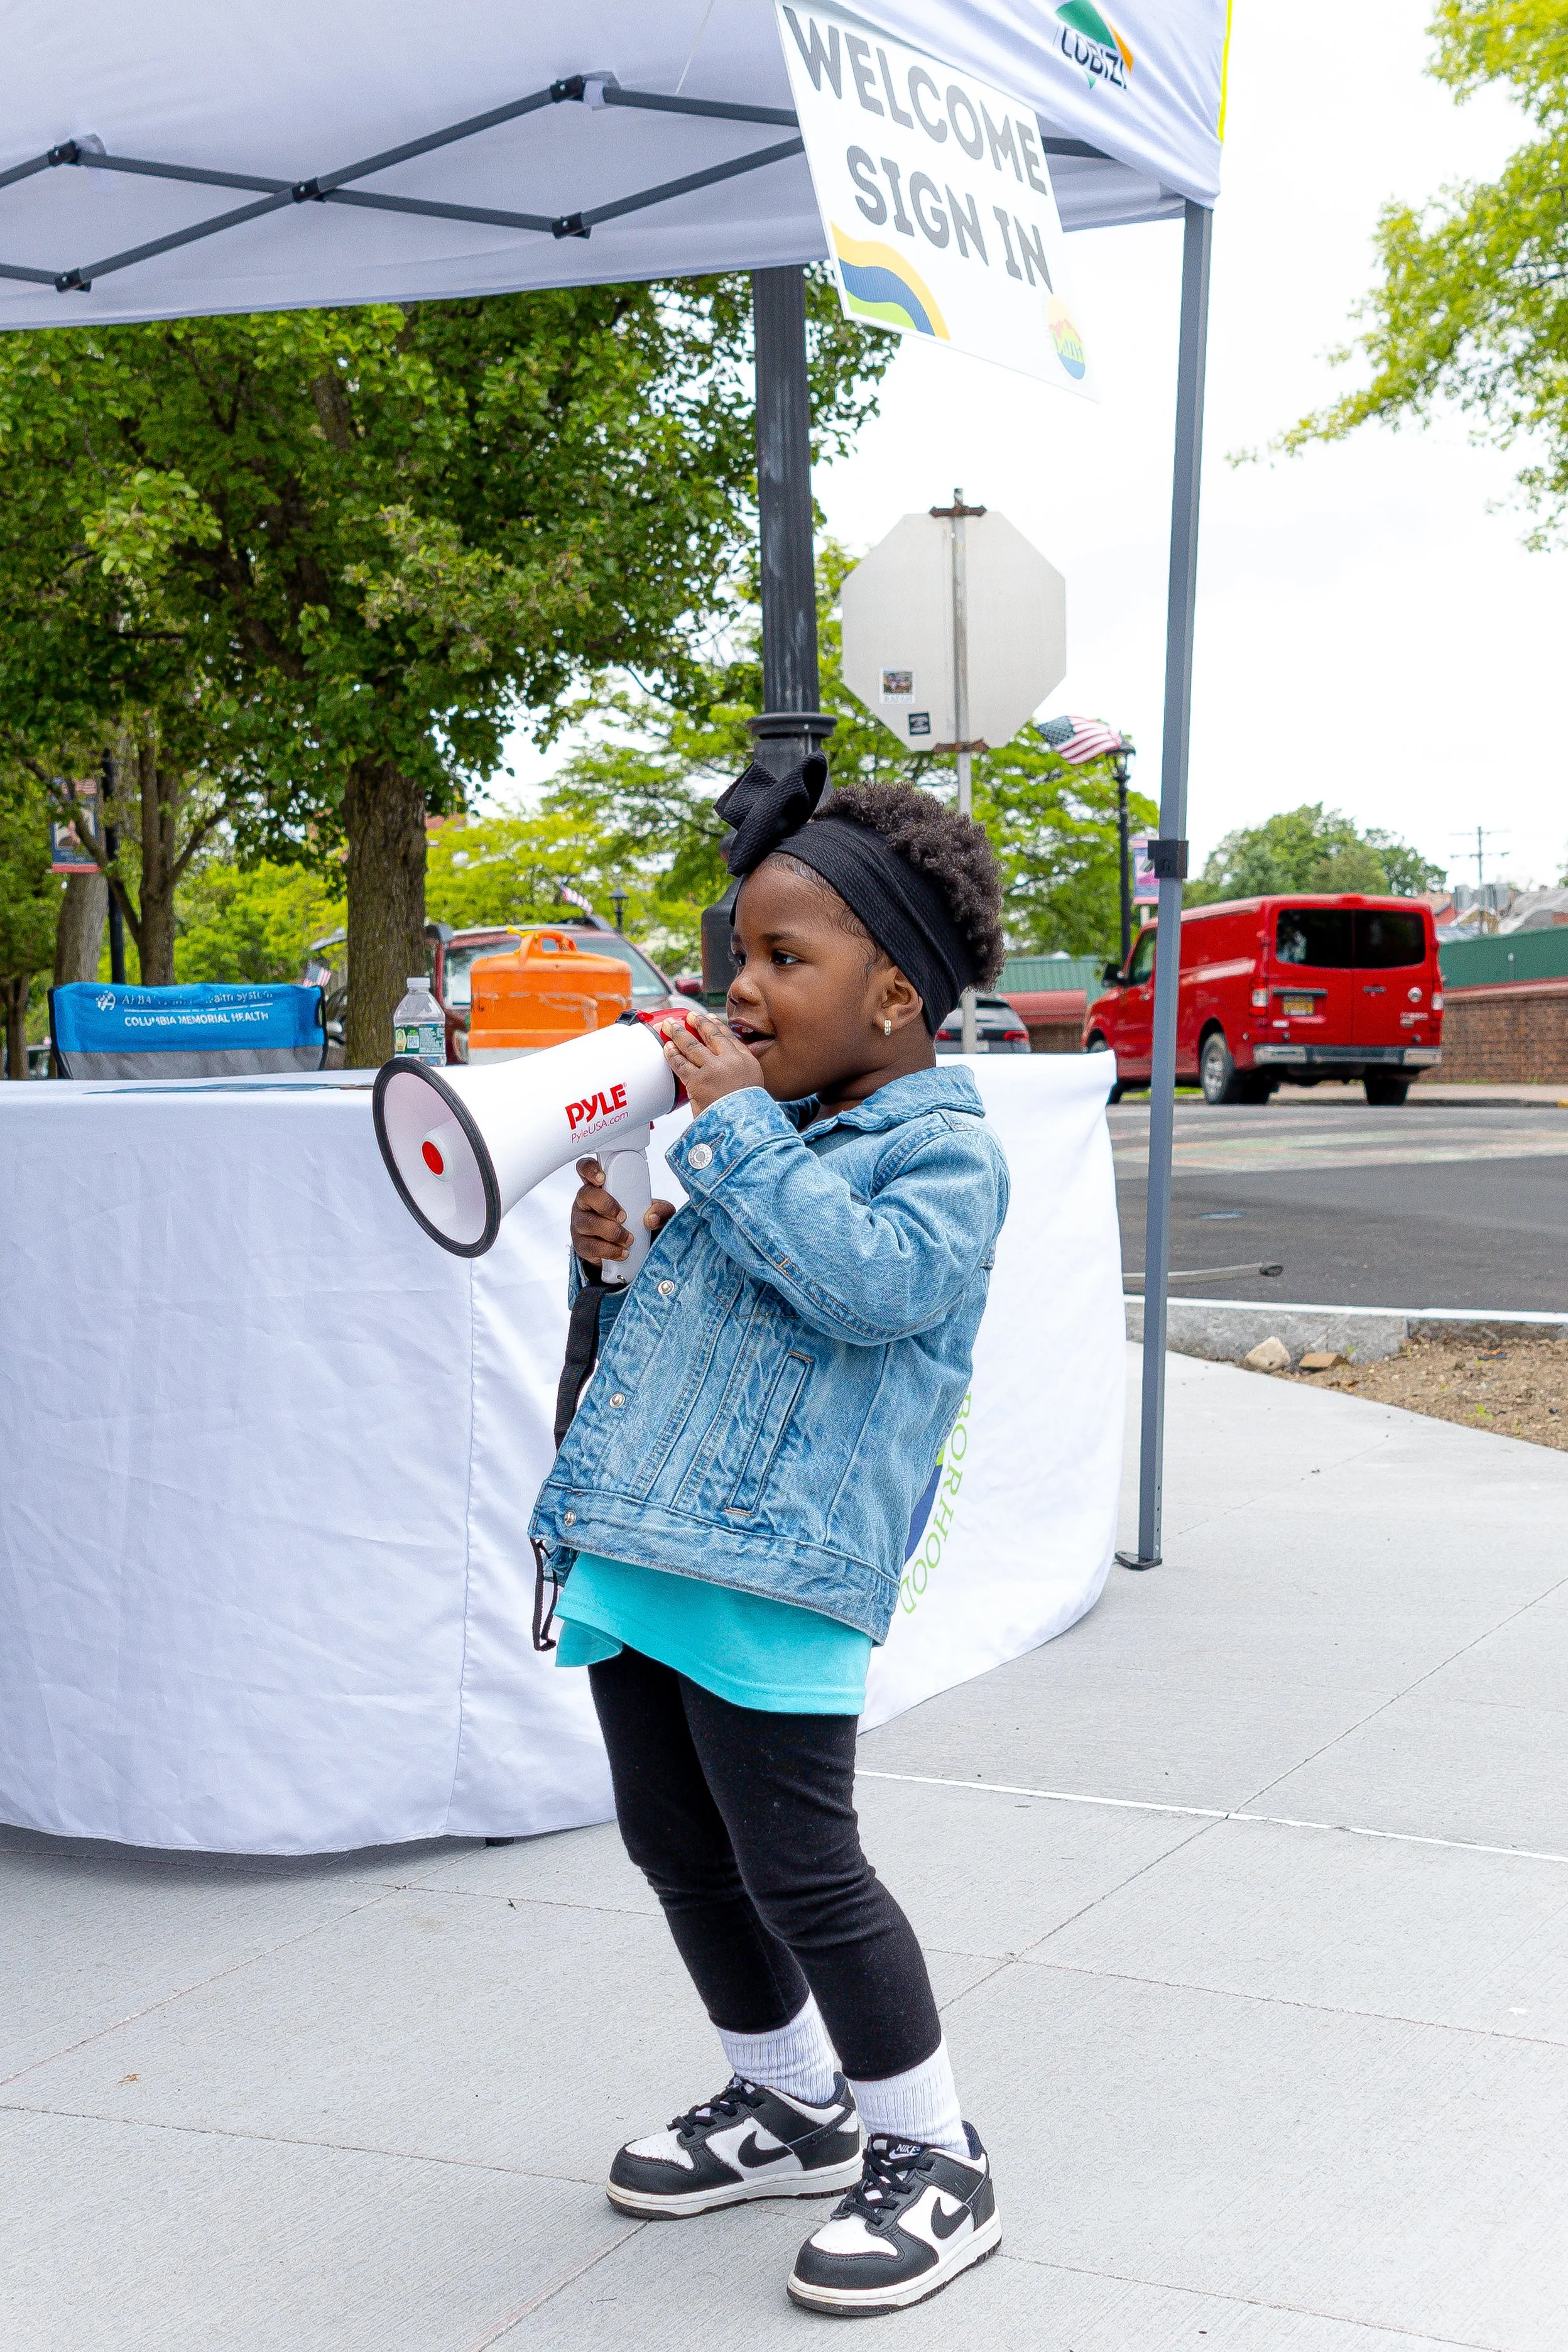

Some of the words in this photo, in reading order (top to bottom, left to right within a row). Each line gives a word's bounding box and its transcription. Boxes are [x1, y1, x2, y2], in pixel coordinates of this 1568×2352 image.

[783, 5, 1047, 196] WELCOME
[846, 145, 989, 267] SIGN
[993, 205, 1054, 295] IN
[178, 1013, 231, 1025] MEMORIAL
[231, 1010, 269, 1023] HEALTH
[565, 1083, 628, 1131] PYLE
[570, 1111, 629, 1144] PyleUSA.com
[896, 2143, 917, 2155] NIKE
